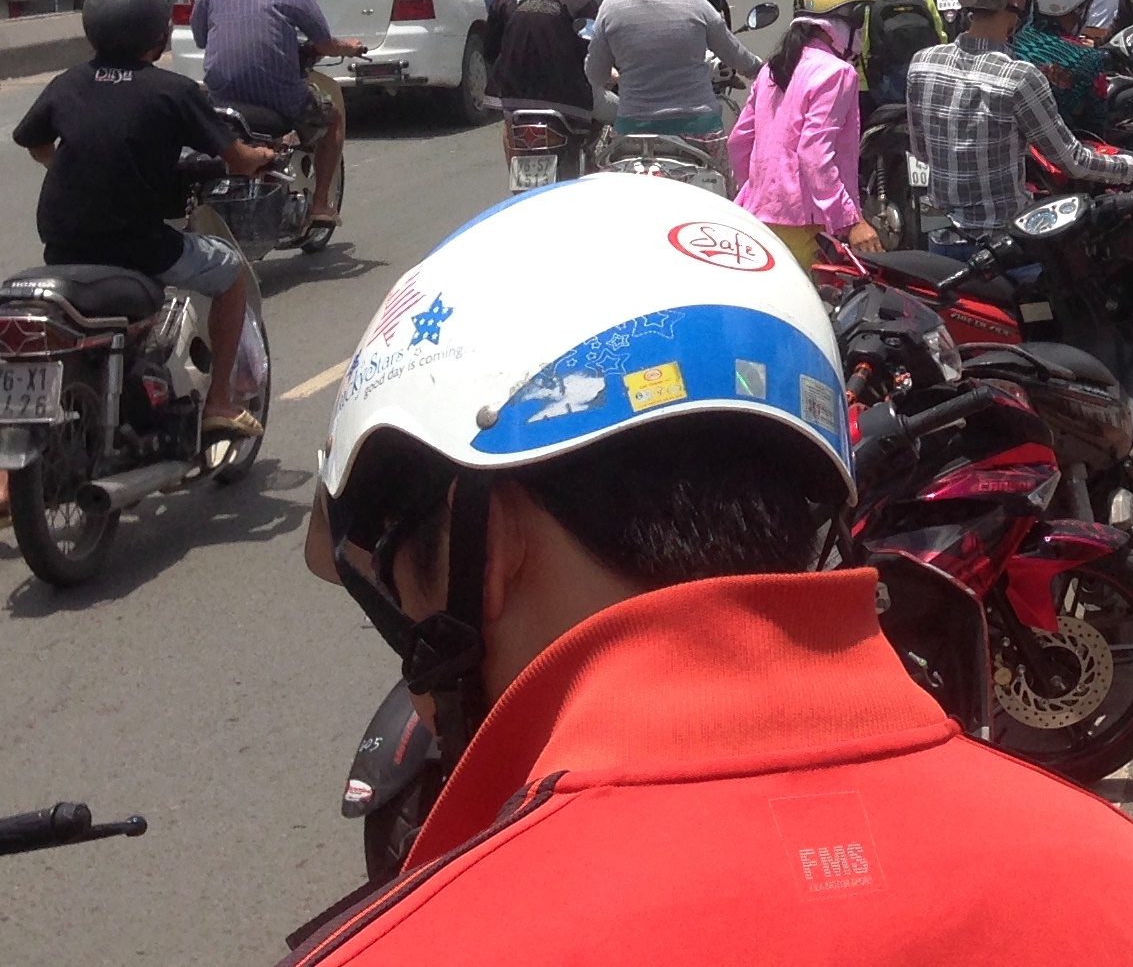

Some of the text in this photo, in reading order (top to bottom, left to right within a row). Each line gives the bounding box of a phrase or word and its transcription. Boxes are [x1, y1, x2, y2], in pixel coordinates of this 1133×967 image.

[690, 226, 756, 265] Safe
[363, 374, 386, 400] good
[388, 364, 405, 381] day
[407, 360, 416, 372] is
[799, 842, 869, 880] FMS
